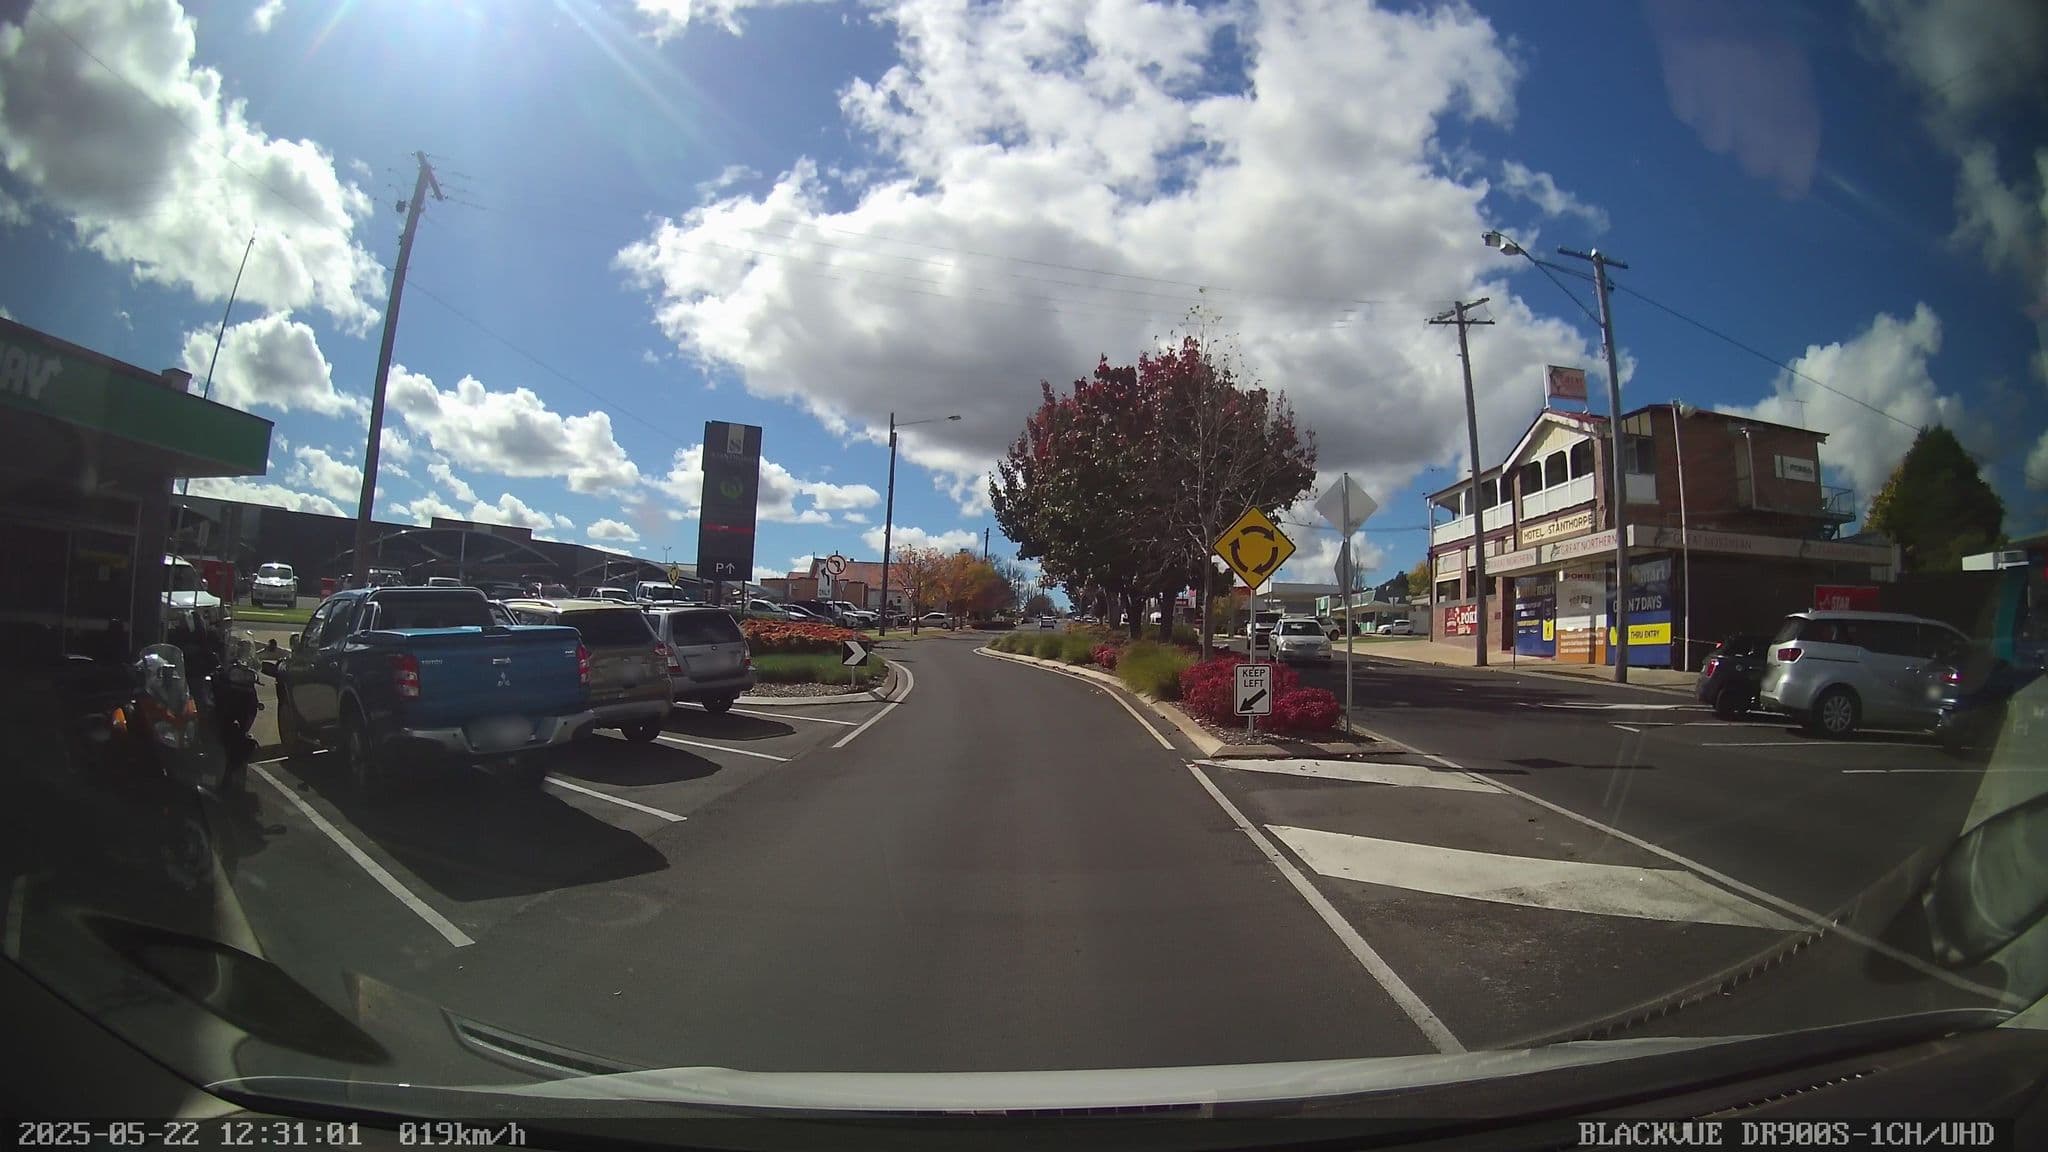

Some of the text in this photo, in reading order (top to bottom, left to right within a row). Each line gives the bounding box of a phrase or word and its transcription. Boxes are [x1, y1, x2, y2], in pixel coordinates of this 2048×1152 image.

[1524, 514, 1592, 541] HOTEL STANTHORPE
[715, 562, 724, 573] P
[1641, 595, 1662, 611] DAYS
[1644, 629, 1660, 639] ENTRY
[1242, 669, 1265, 678] KEEP
[1244, 679, 1264, 688] LEFT
